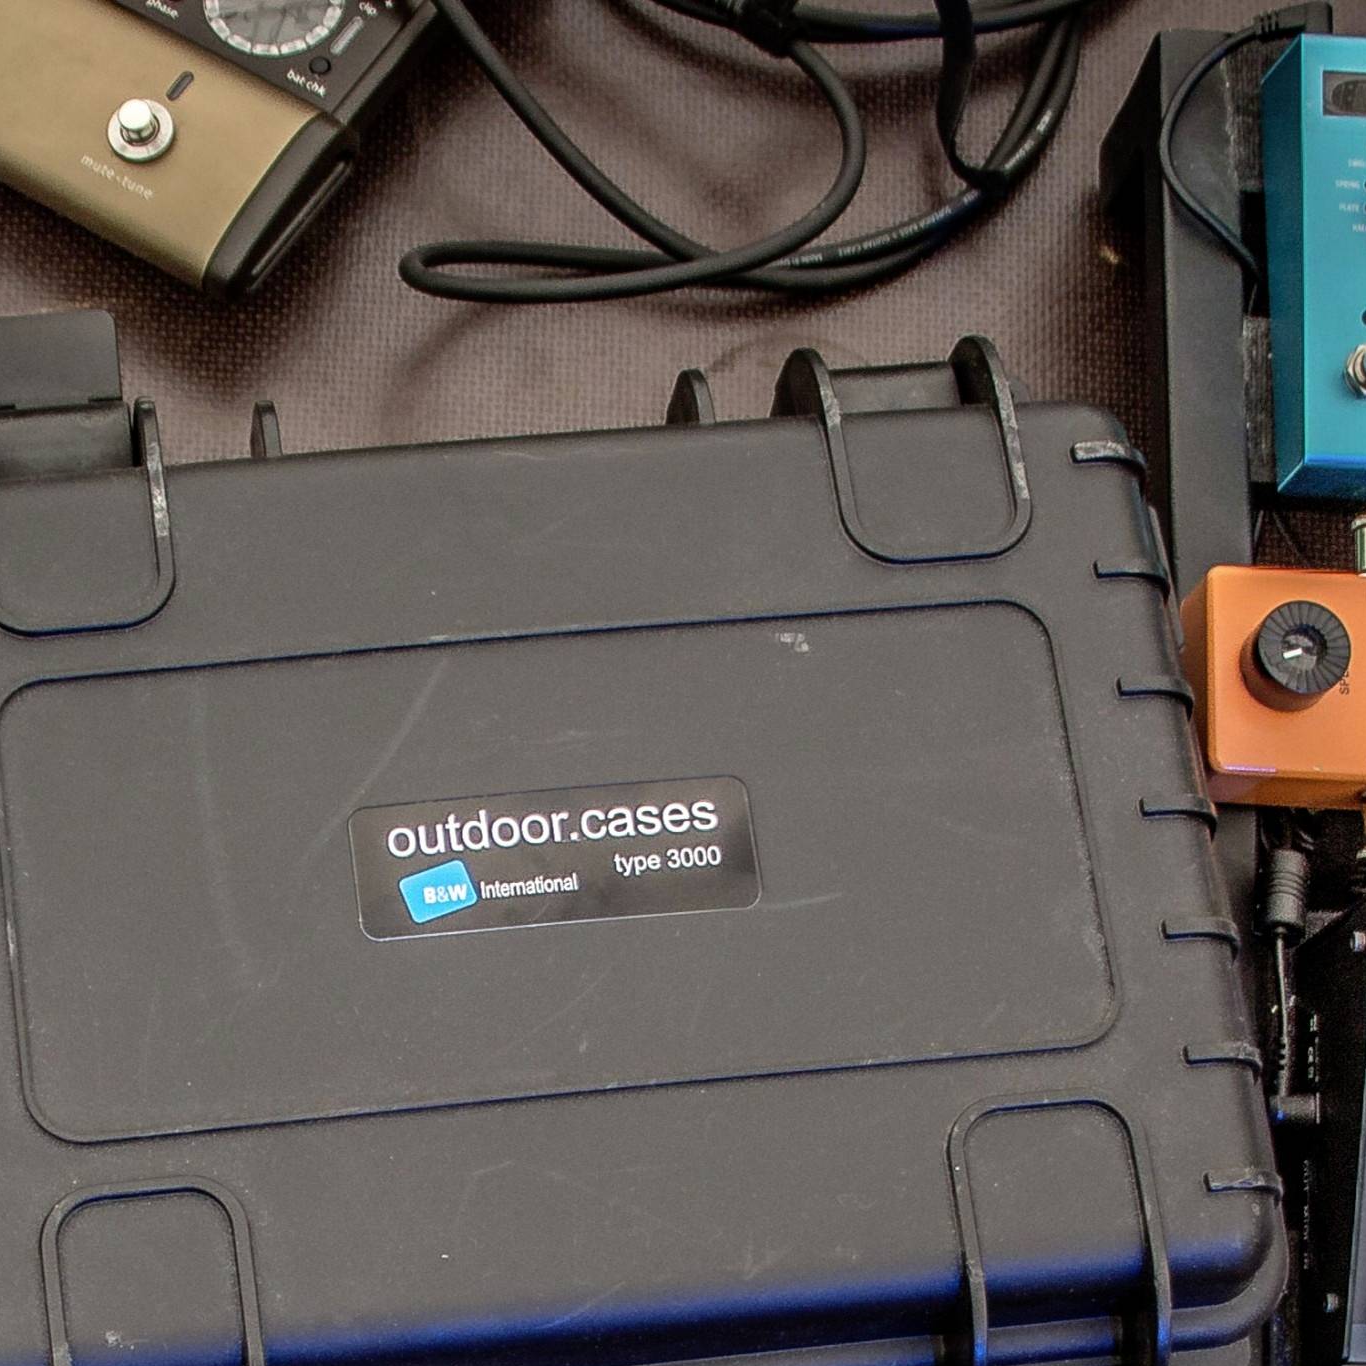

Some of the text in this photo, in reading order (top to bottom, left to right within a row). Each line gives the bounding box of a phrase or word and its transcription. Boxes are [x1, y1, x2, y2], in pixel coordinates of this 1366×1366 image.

[386, 797, 720, 860] outdoor.cases
[613, 844, 723, 878] type 3000
[422, 882, 469, 906] B&W
[480, 872, 580, 901] International
